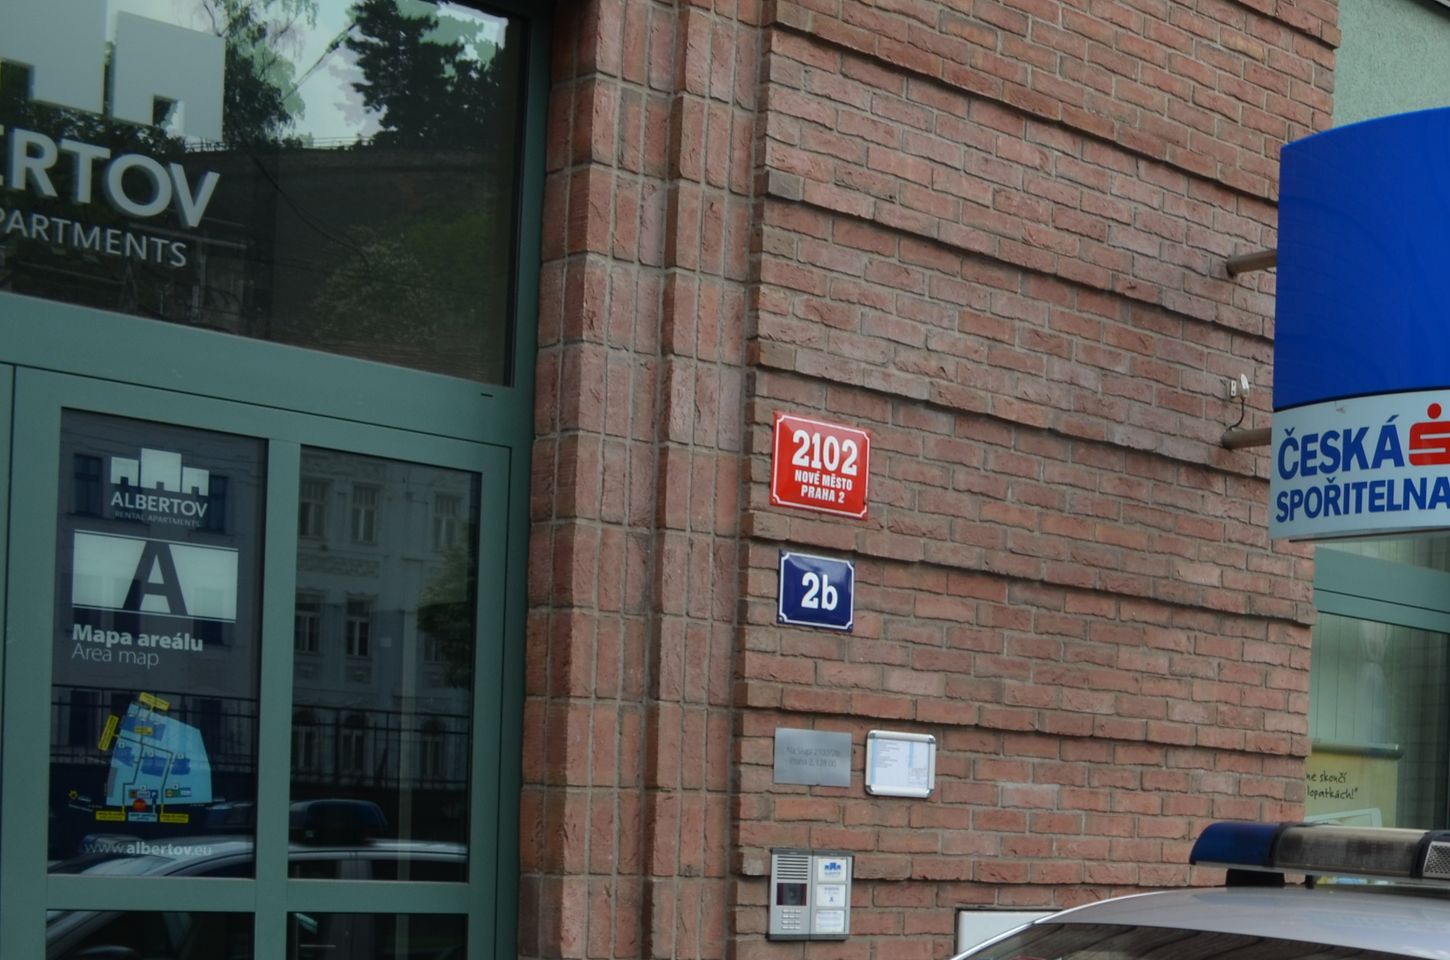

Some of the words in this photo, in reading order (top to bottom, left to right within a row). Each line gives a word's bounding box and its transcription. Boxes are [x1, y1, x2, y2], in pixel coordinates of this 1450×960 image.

[0, 124, 220, 228] RTOV
[791, 429, 858, 477] 2102
[1277, 414, 1405, 481] ČESKÁ
[794, 468, 820, 485] NOVÉ
[822, 472, 853, 491] MĚSTO
[110, 491, 209, 518] ALBERTOV
[800, 485, 835, 503] PRAHA
[837, 491, 845, 504] 2
[147, 514, 202, 529] APARTMENTS
[122, 538, 189, 616] A
[800, 571, 838, 611] 2b
[72, 624, 132, 648] Mapa
[137, 629, 203, 651] areálu
[72, 642, 112, 662] Area
[118, 650, 160, 670] map
[84, 841, 212, 857] www.albertov.eu
